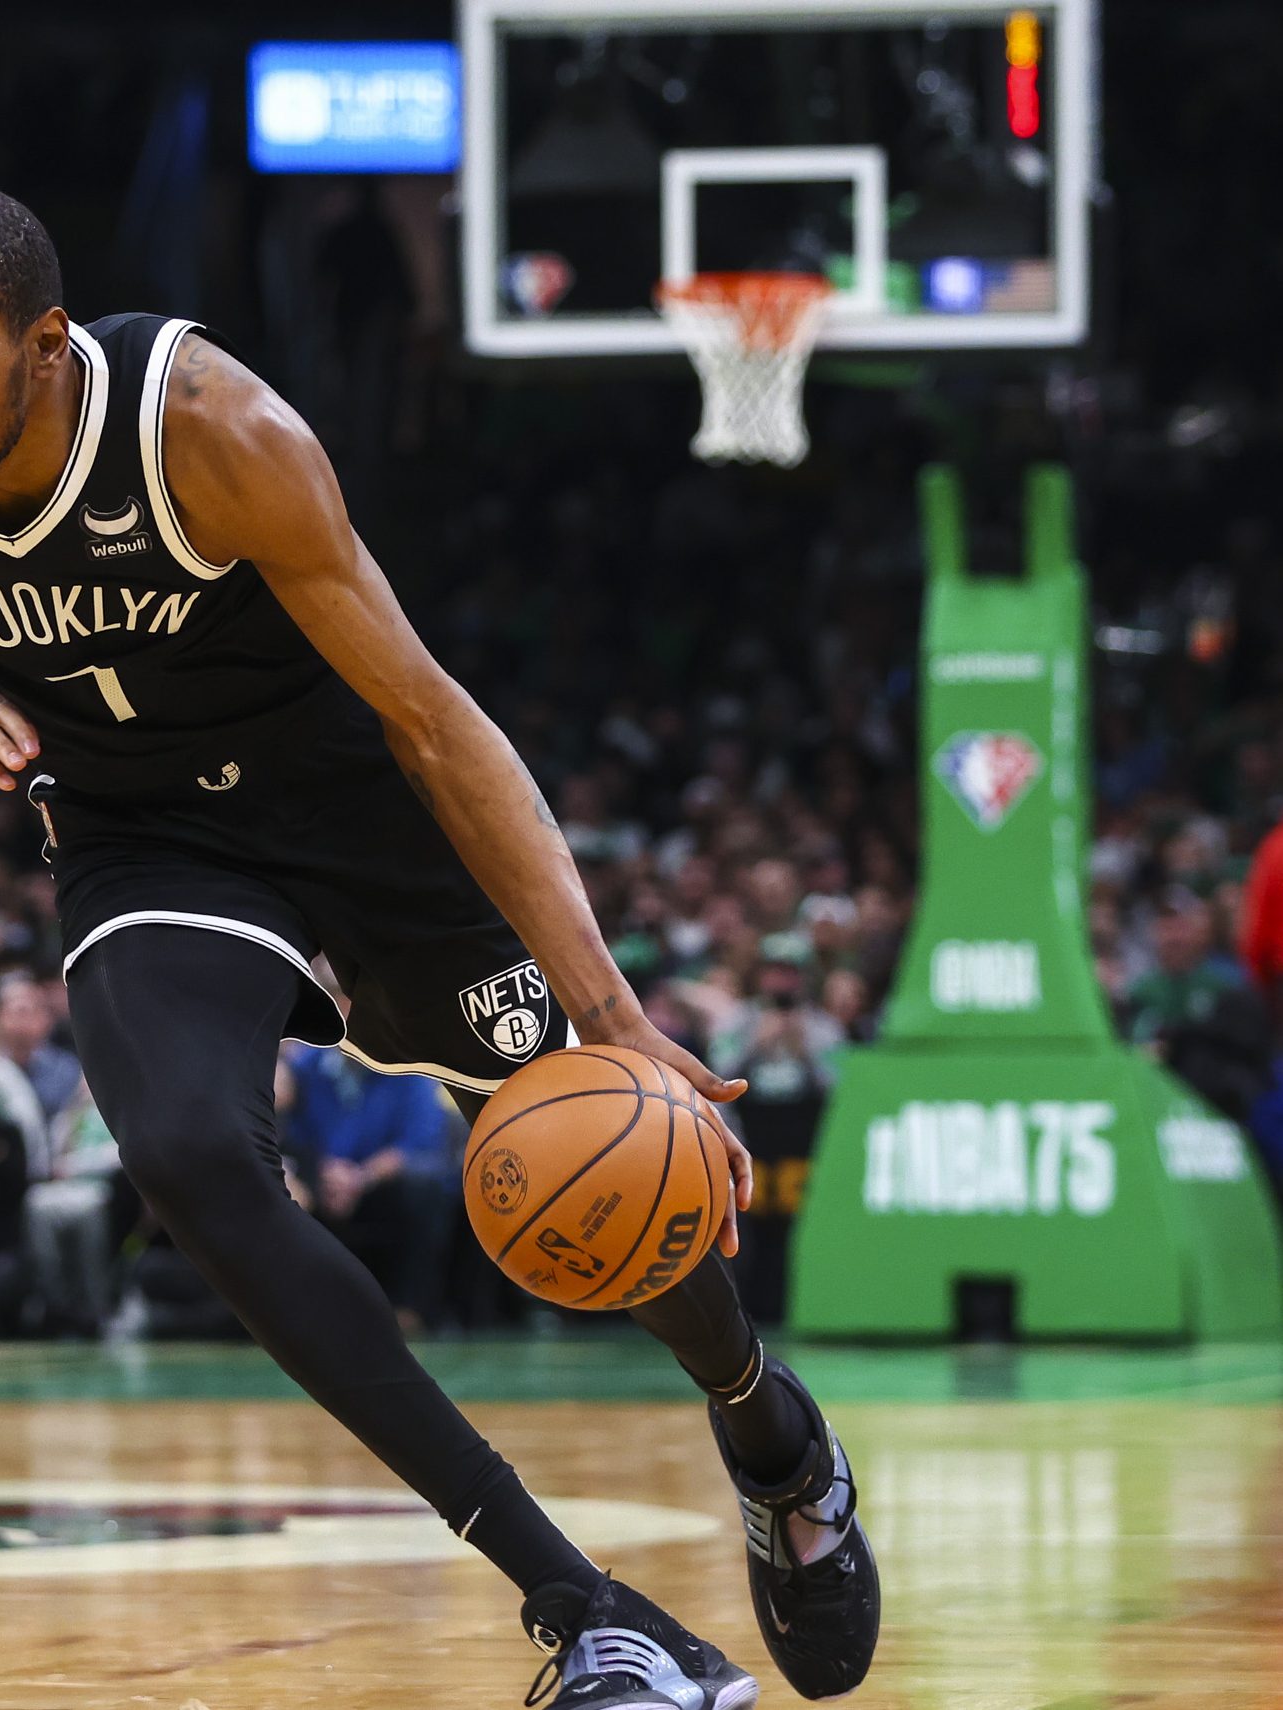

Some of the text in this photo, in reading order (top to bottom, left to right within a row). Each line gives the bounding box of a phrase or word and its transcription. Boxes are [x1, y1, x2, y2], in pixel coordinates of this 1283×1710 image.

[91, 538, 147, 558] Webull
[44, 665, 137, 722] 7
[467, 964, 545, 1023] NETS
[508, 1016, 527, 1049] B
